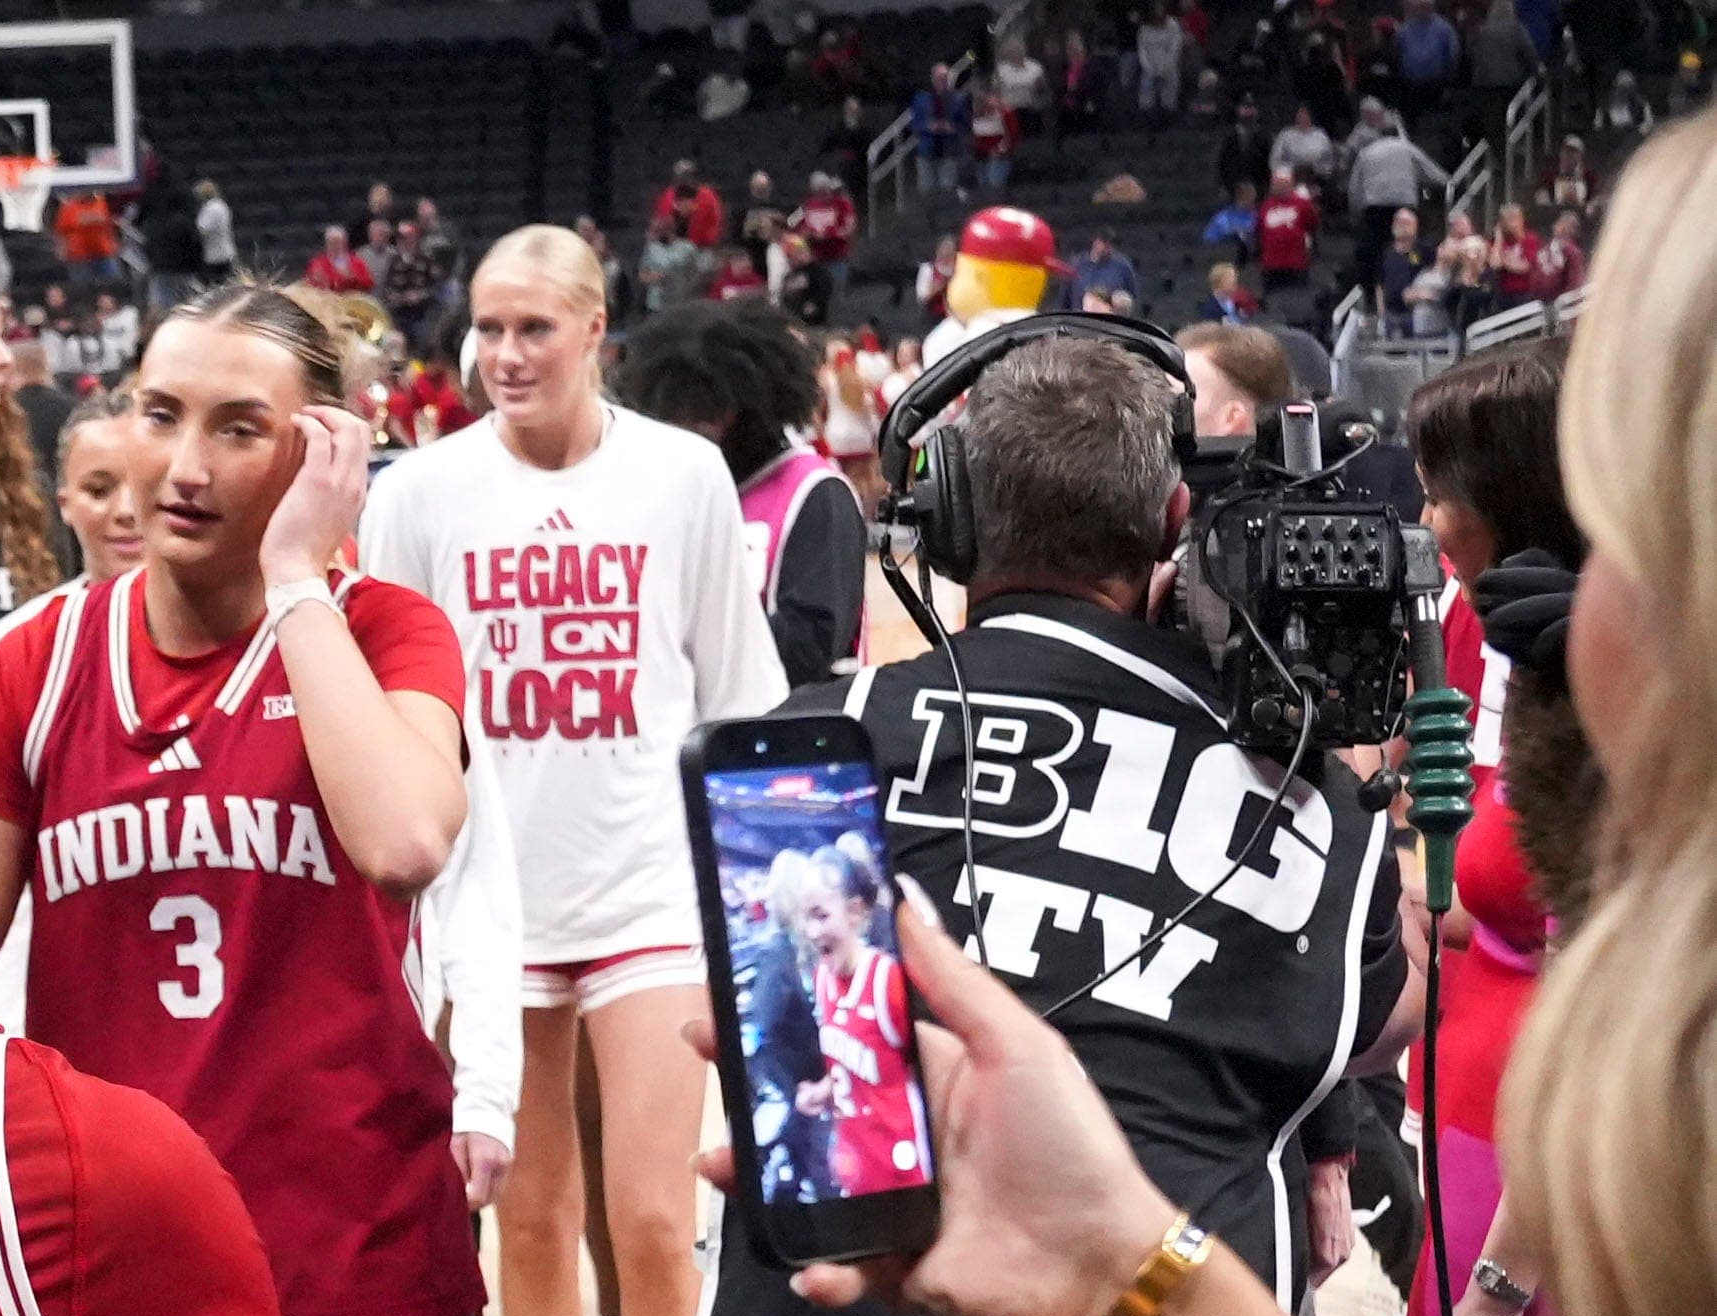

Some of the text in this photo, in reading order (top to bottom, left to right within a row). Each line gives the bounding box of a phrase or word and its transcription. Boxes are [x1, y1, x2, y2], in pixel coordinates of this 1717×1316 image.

[464, 544, 648, 611] LEGACY
[549, 619, 632, 656] ON
[480, 668, 638, 741] LOCK
[38, 795, 337, 902] INDIANA
[149, 894, 225, 1019] 3
[953, 863, 1219, 1021] TV
